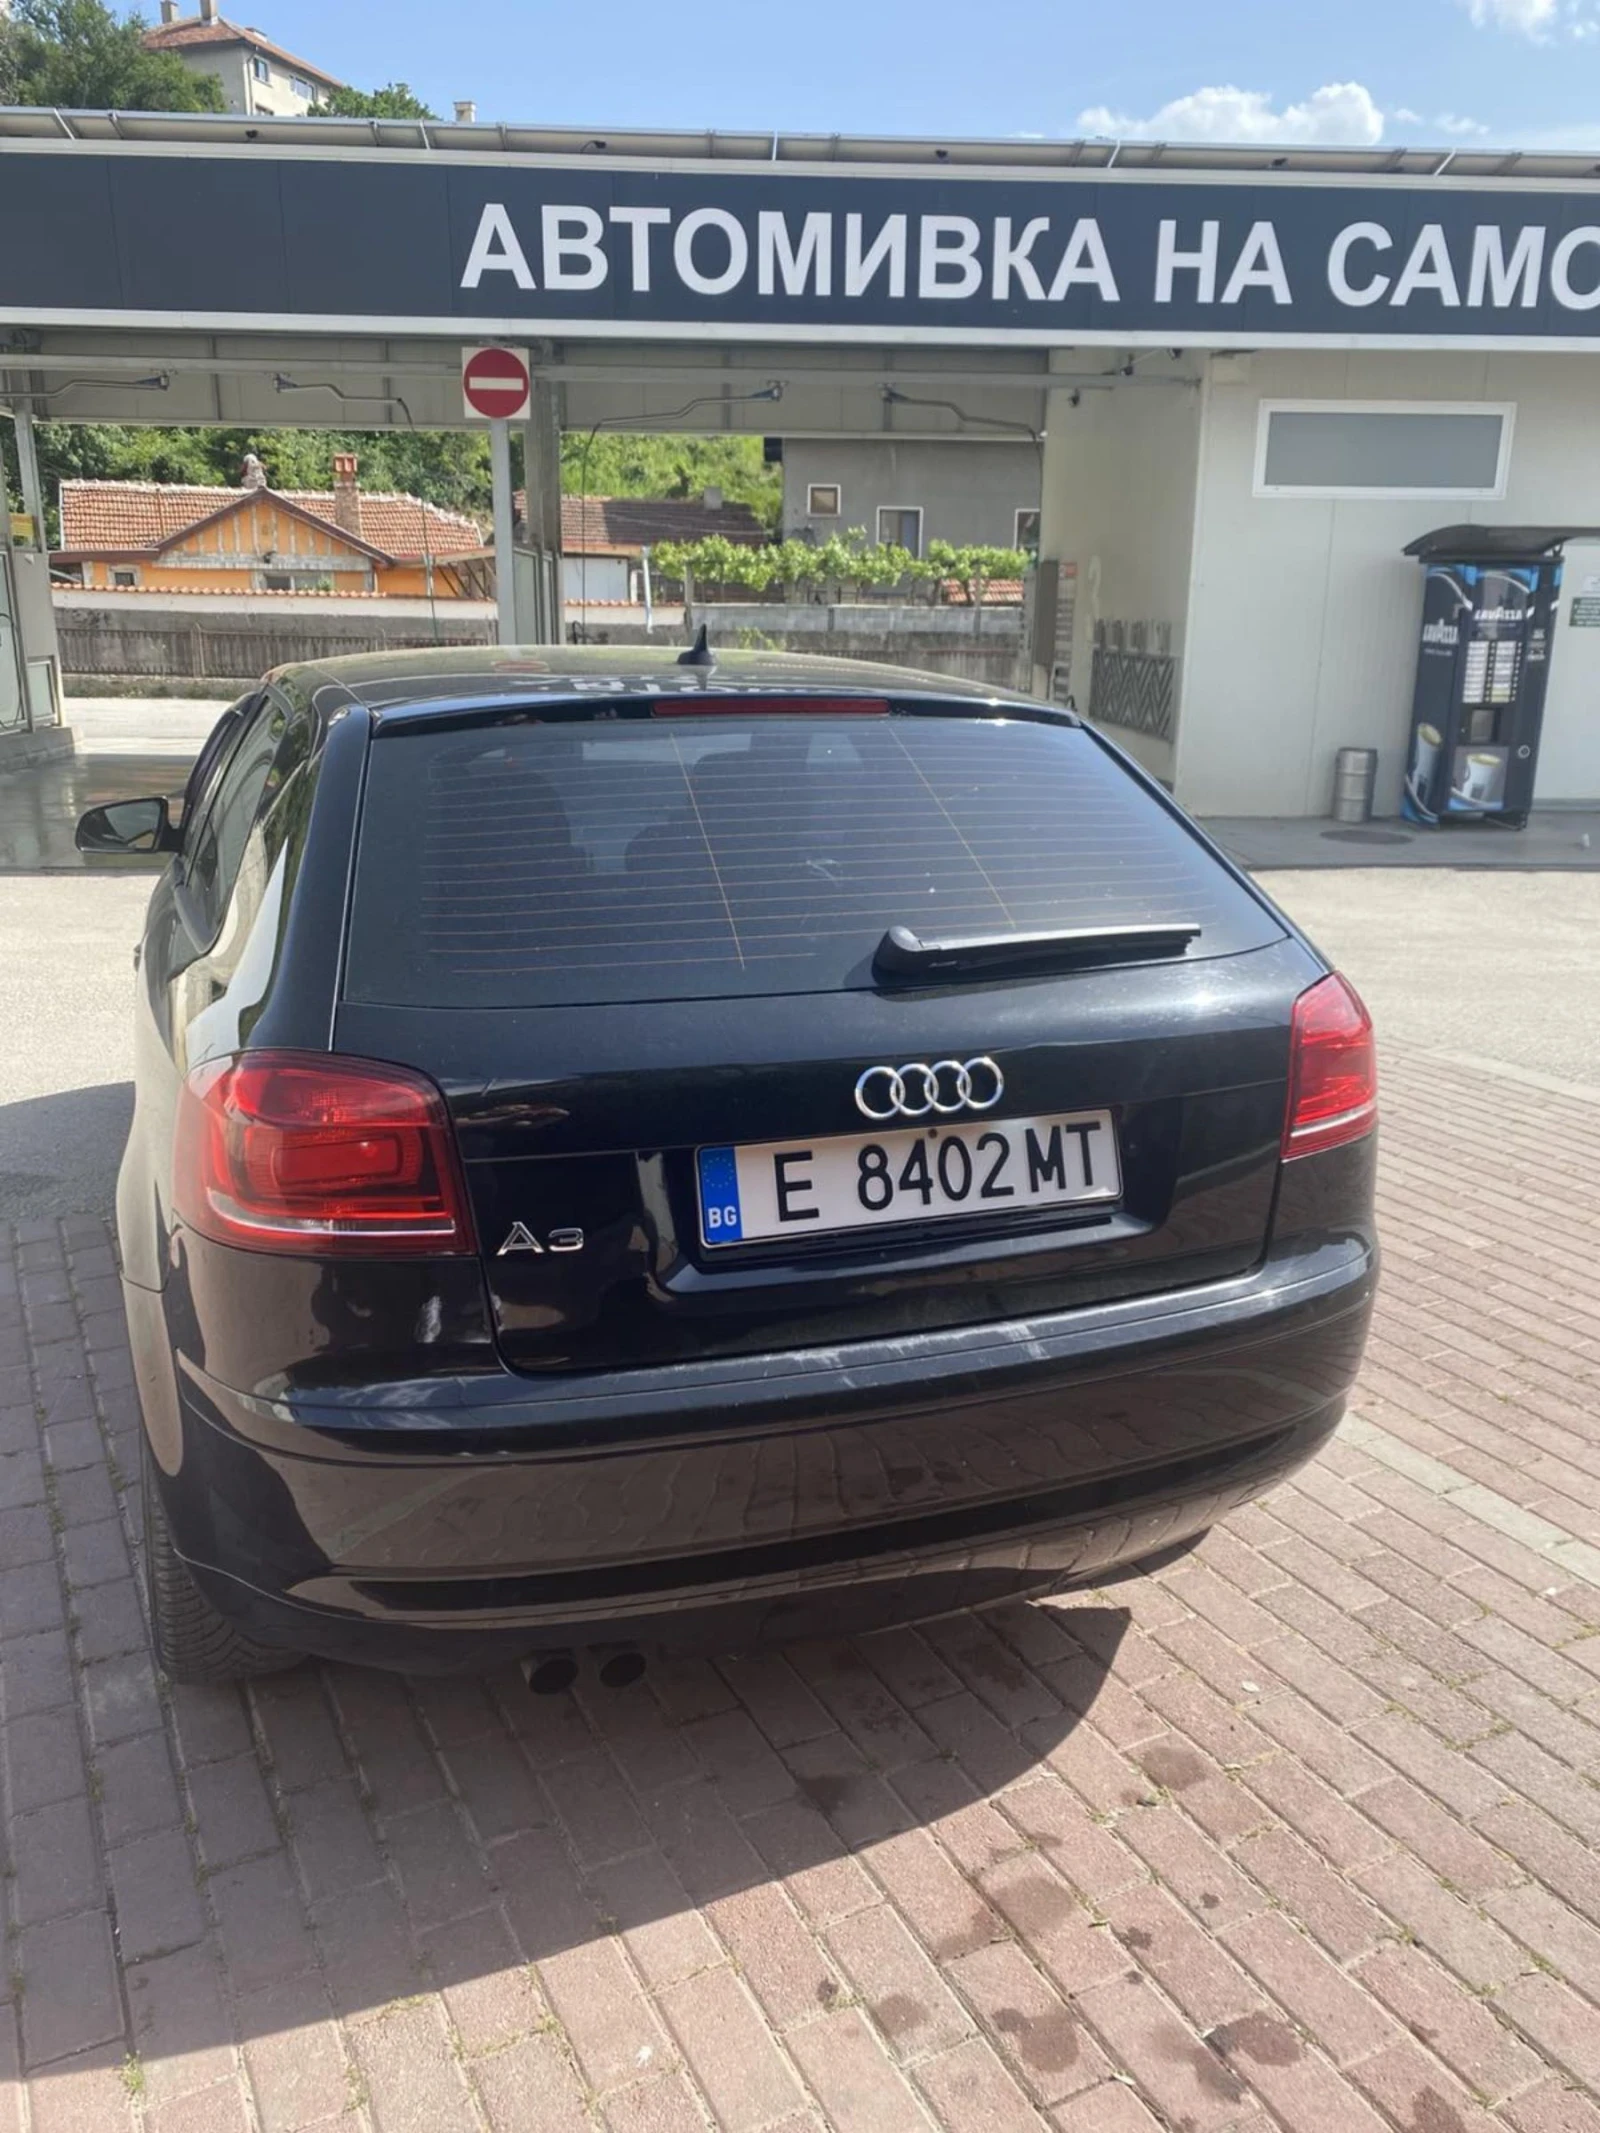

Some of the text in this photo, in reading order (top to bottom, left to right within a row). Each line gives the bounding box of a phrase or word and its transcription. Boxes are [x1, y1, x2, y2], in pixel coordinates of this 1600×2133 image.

[460, 203, 1120, 302] АВТОМИВКА
[1154, 219, 1293, 304] НА
[774, 1149, 819, 1222] E
[857, 1131, 1014, 1211] 8402
[497, 1221, 584, 1256] A3
[708, 1206, 737, 1229] BG
